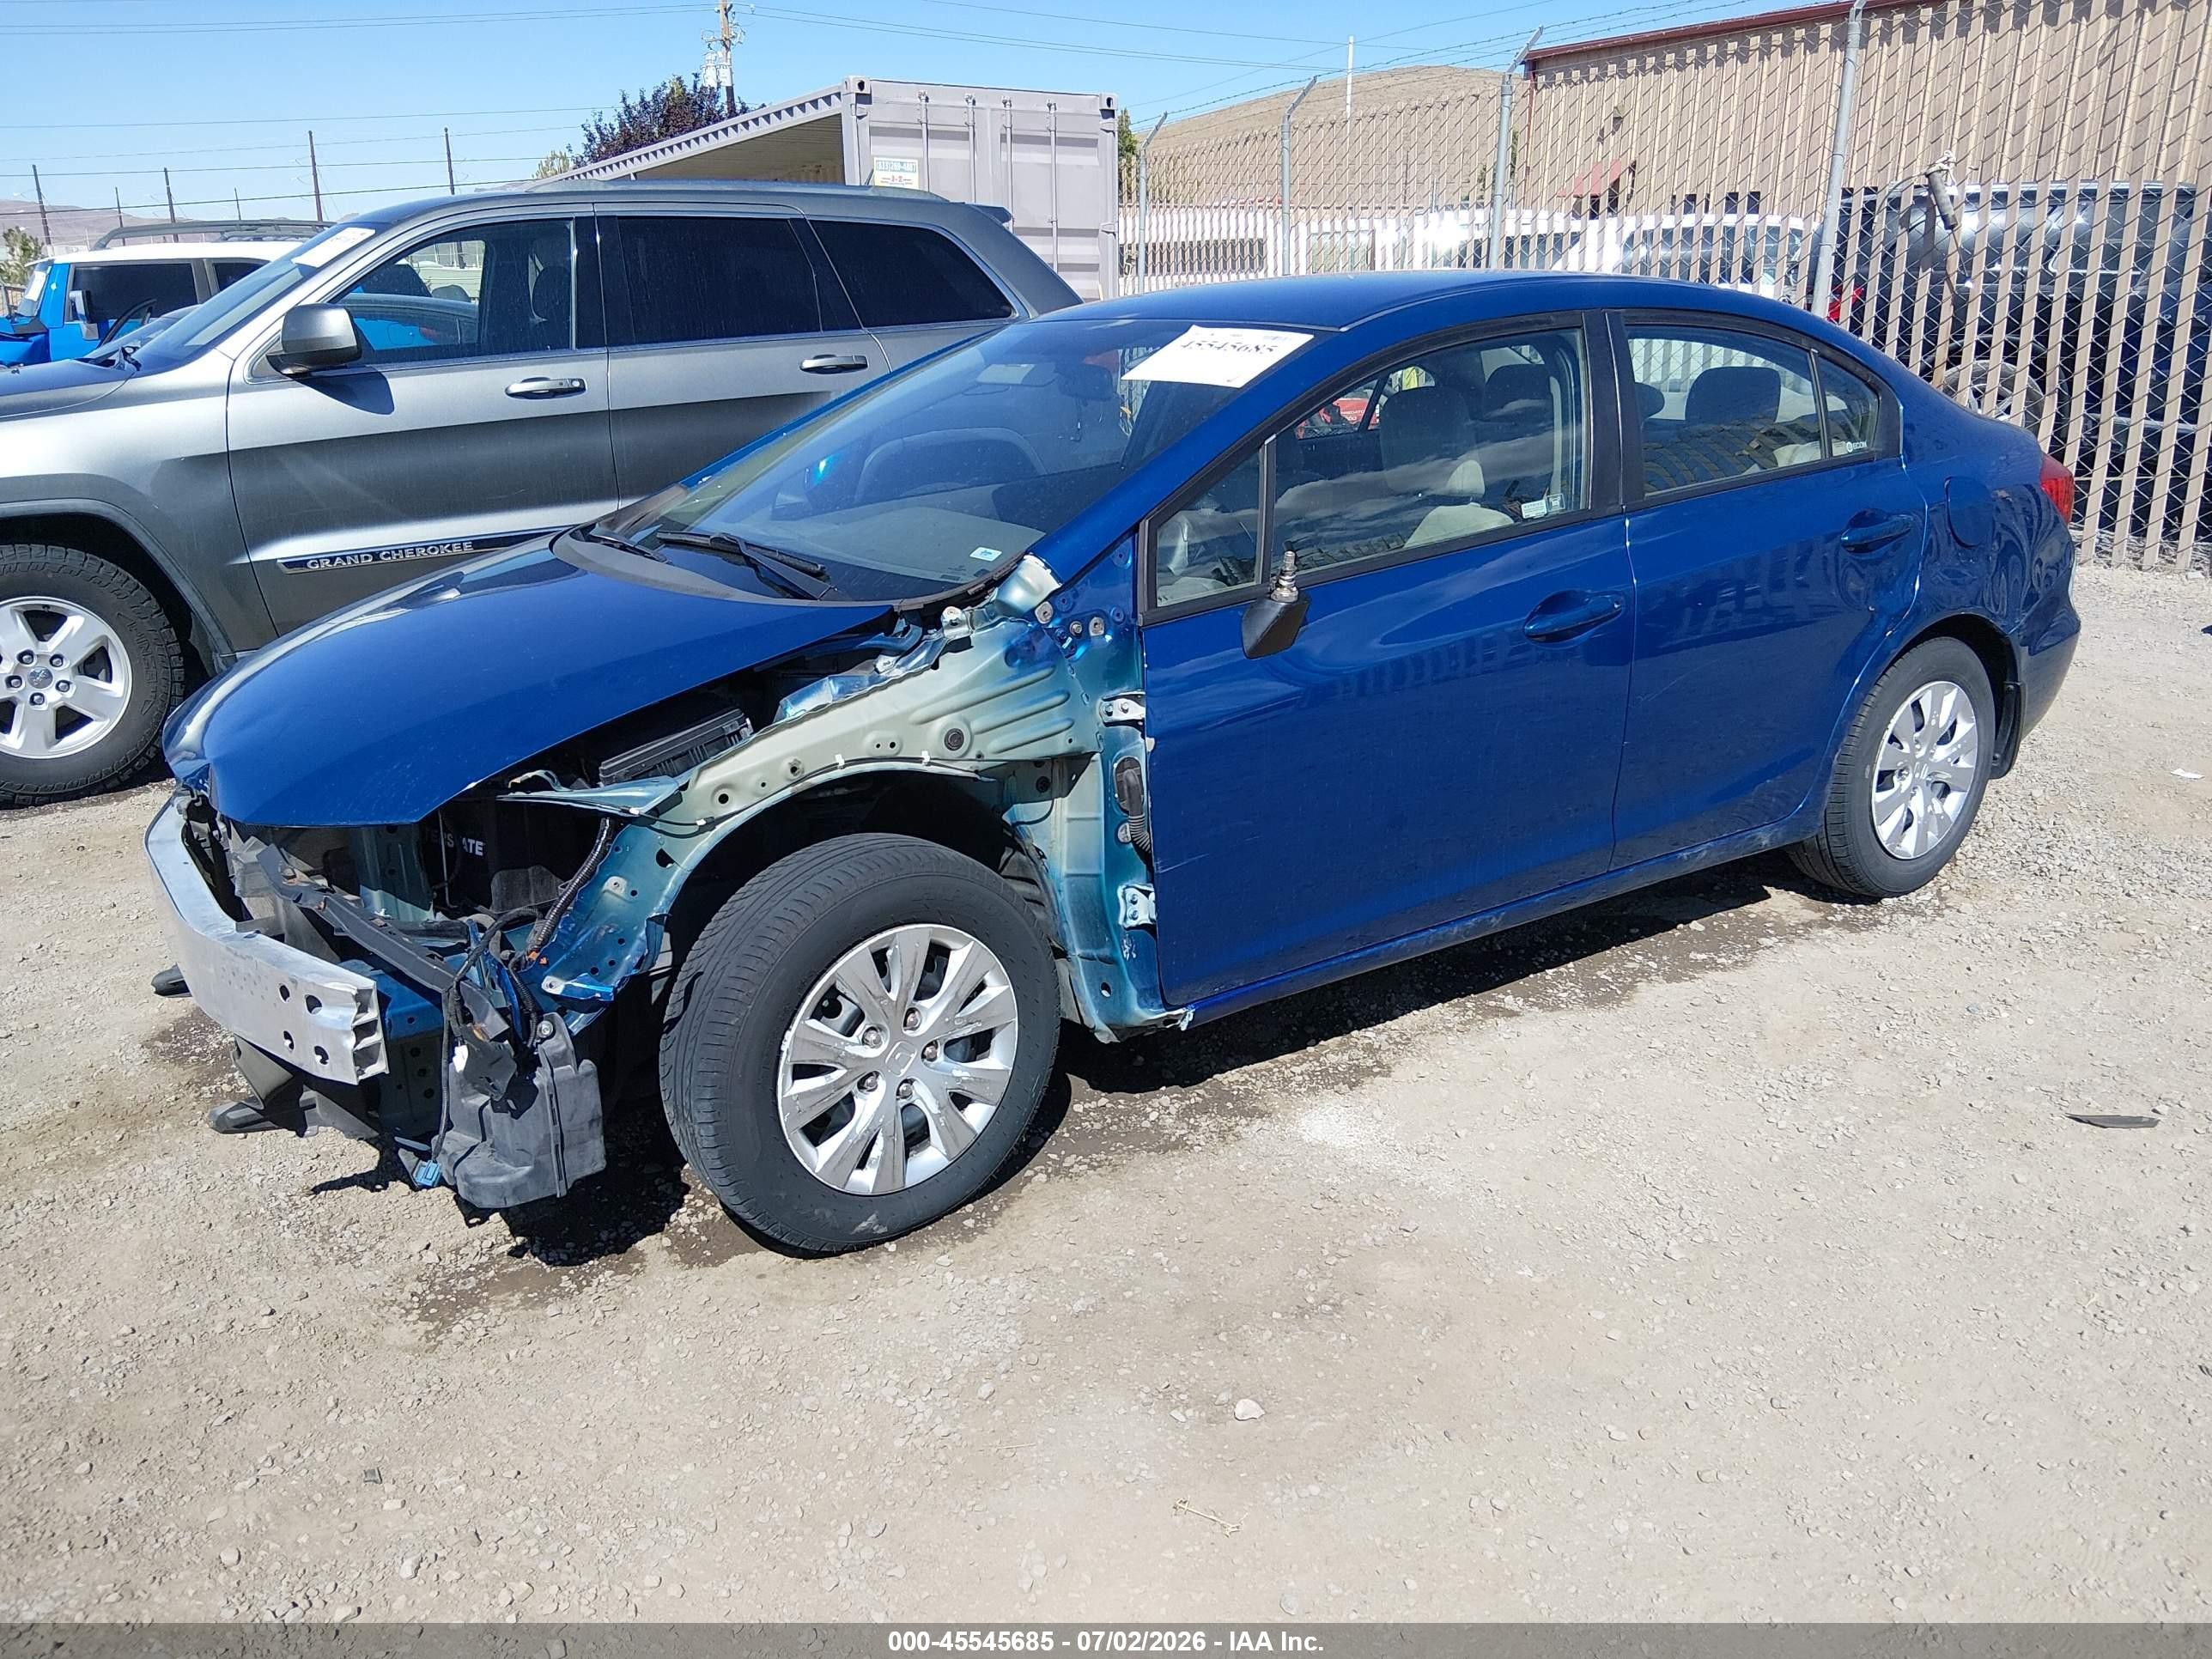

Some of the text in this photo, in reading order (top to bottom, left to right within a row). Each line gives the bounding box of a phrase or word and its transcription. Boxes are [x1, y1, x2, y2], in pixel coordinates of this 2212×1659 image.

[1181, 340, 1279, 355] 45545685
[306, 541, 474, 569] GRAND CHEROKEE
